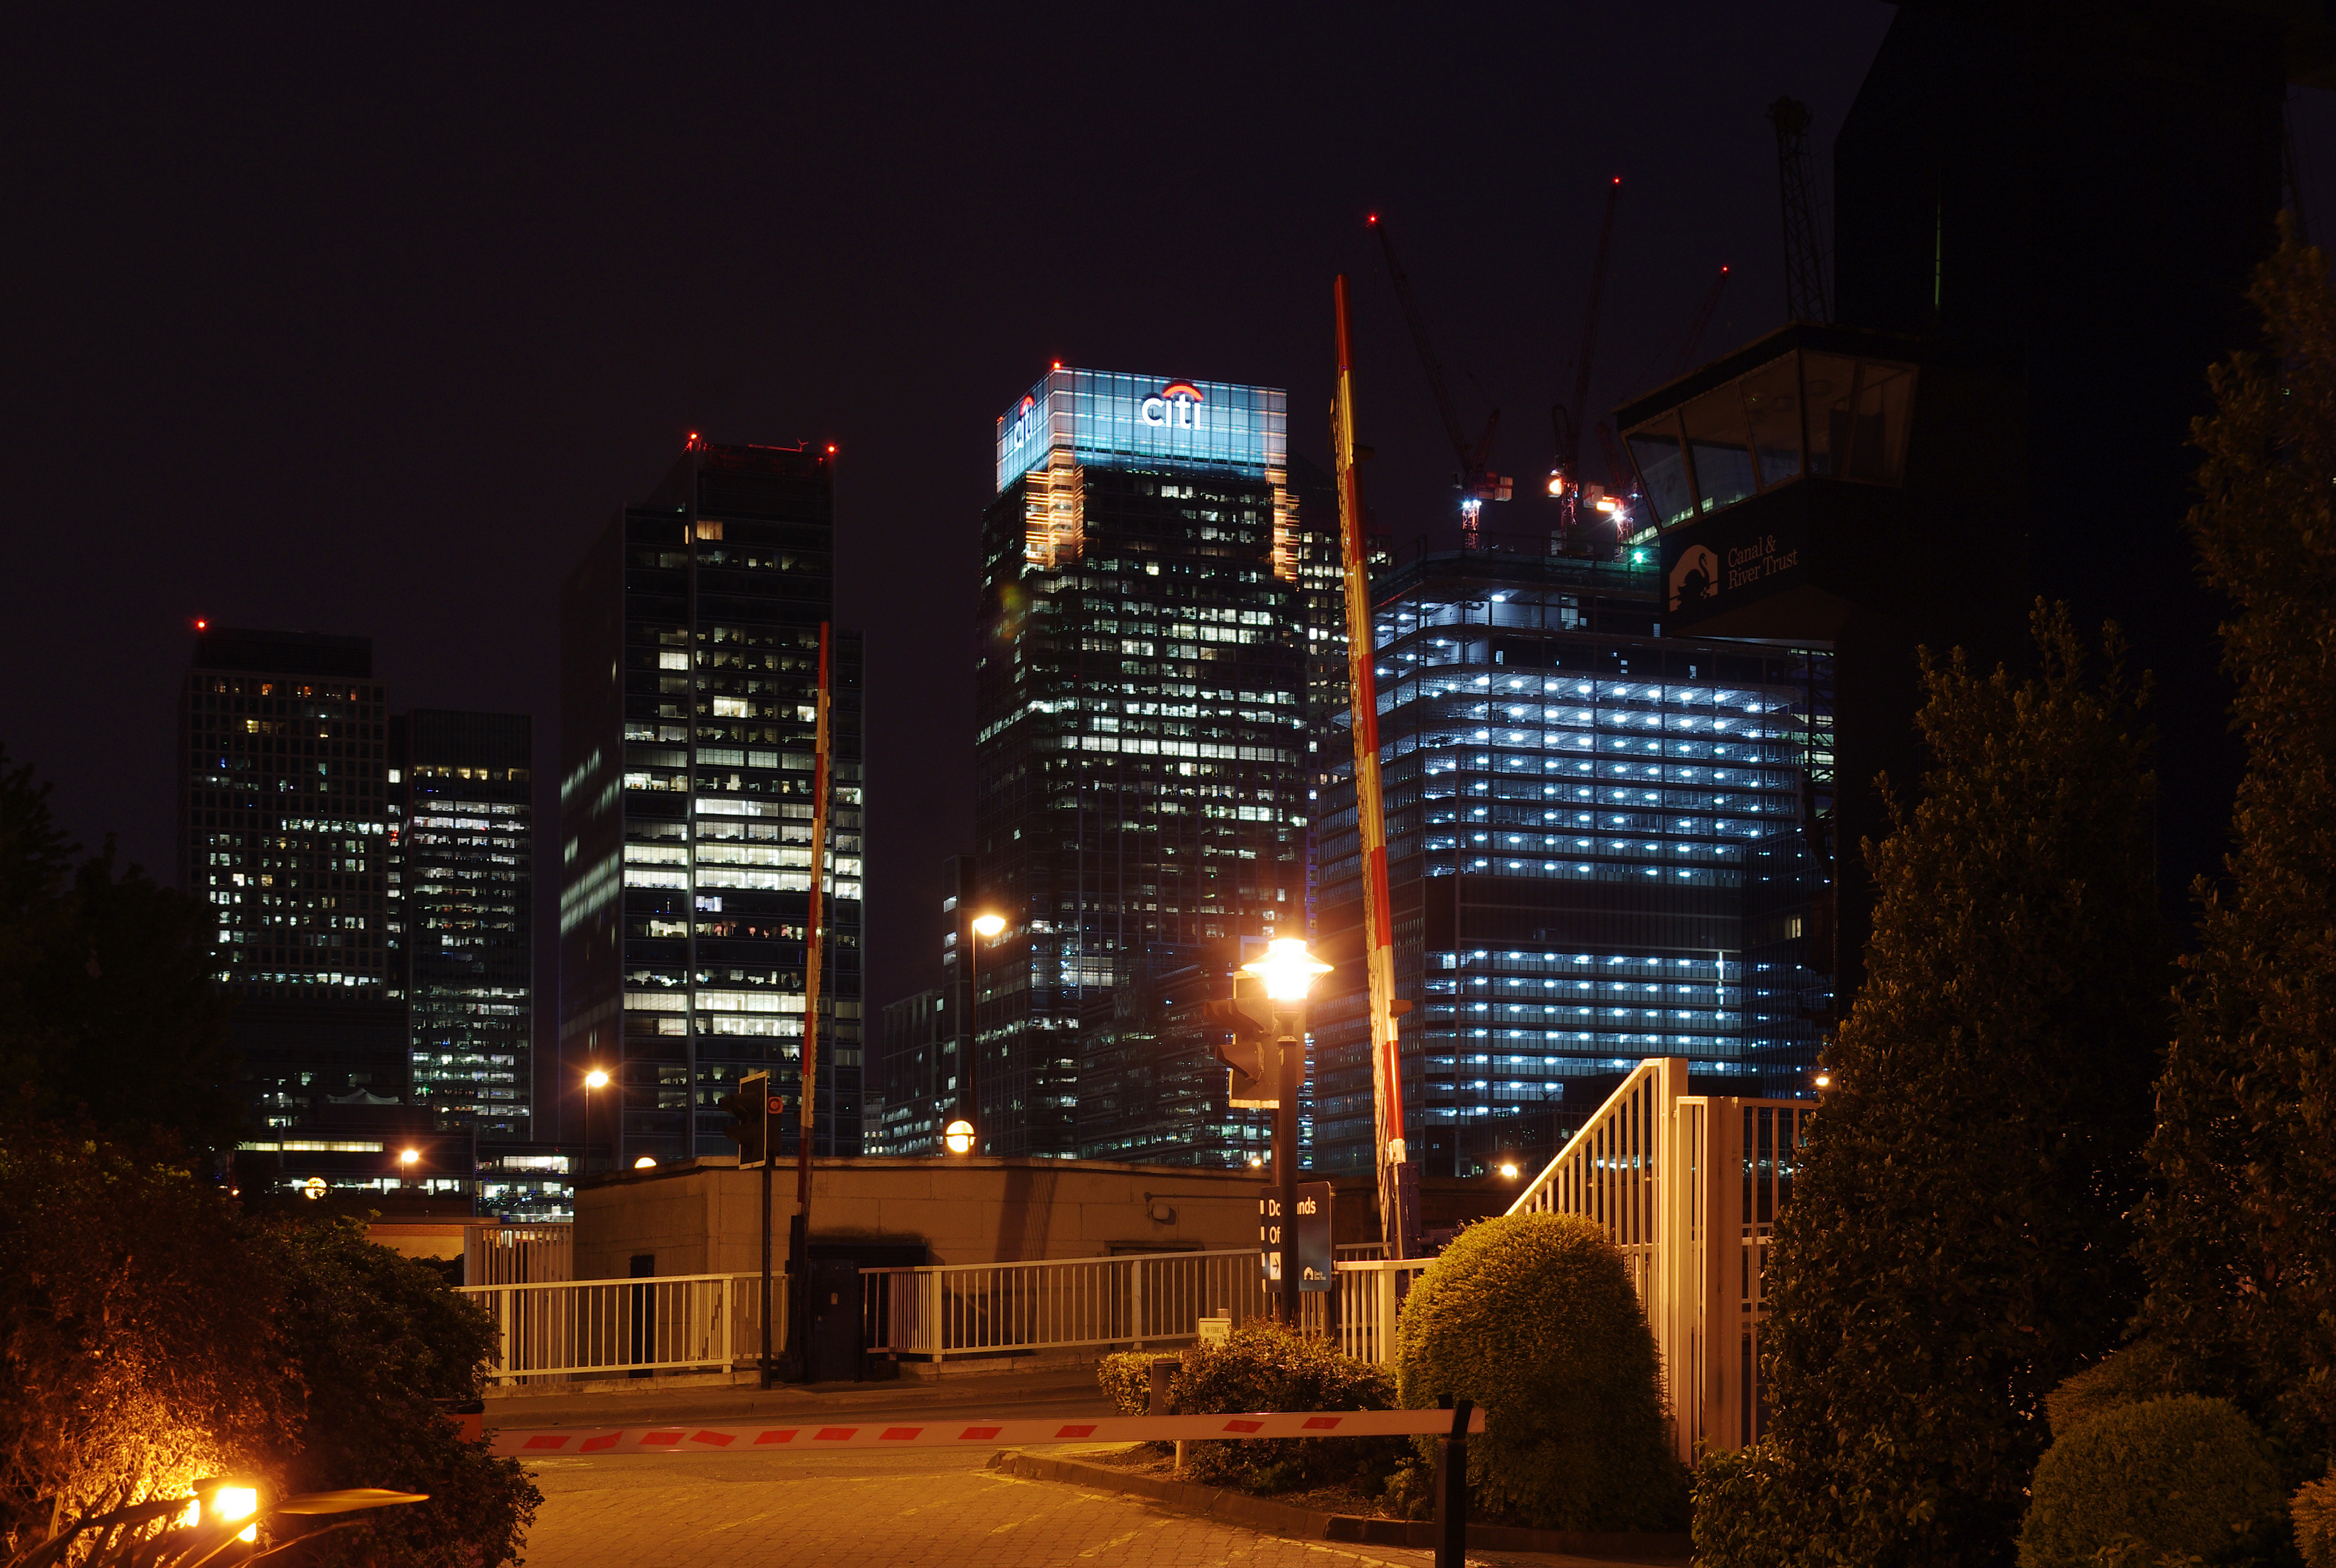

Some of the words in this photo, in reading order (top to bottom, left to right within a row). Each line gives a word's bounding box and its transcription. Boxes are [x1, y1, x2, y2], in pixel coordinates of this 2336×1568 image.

[1141, 387, 1203, 430] citi
[1727, 537, 1764, 568] Canal
[1765, 535, 1776, 554] &
[1728, 563, 1761, 590] River
[1762, 549, 1798, 576] Trust
